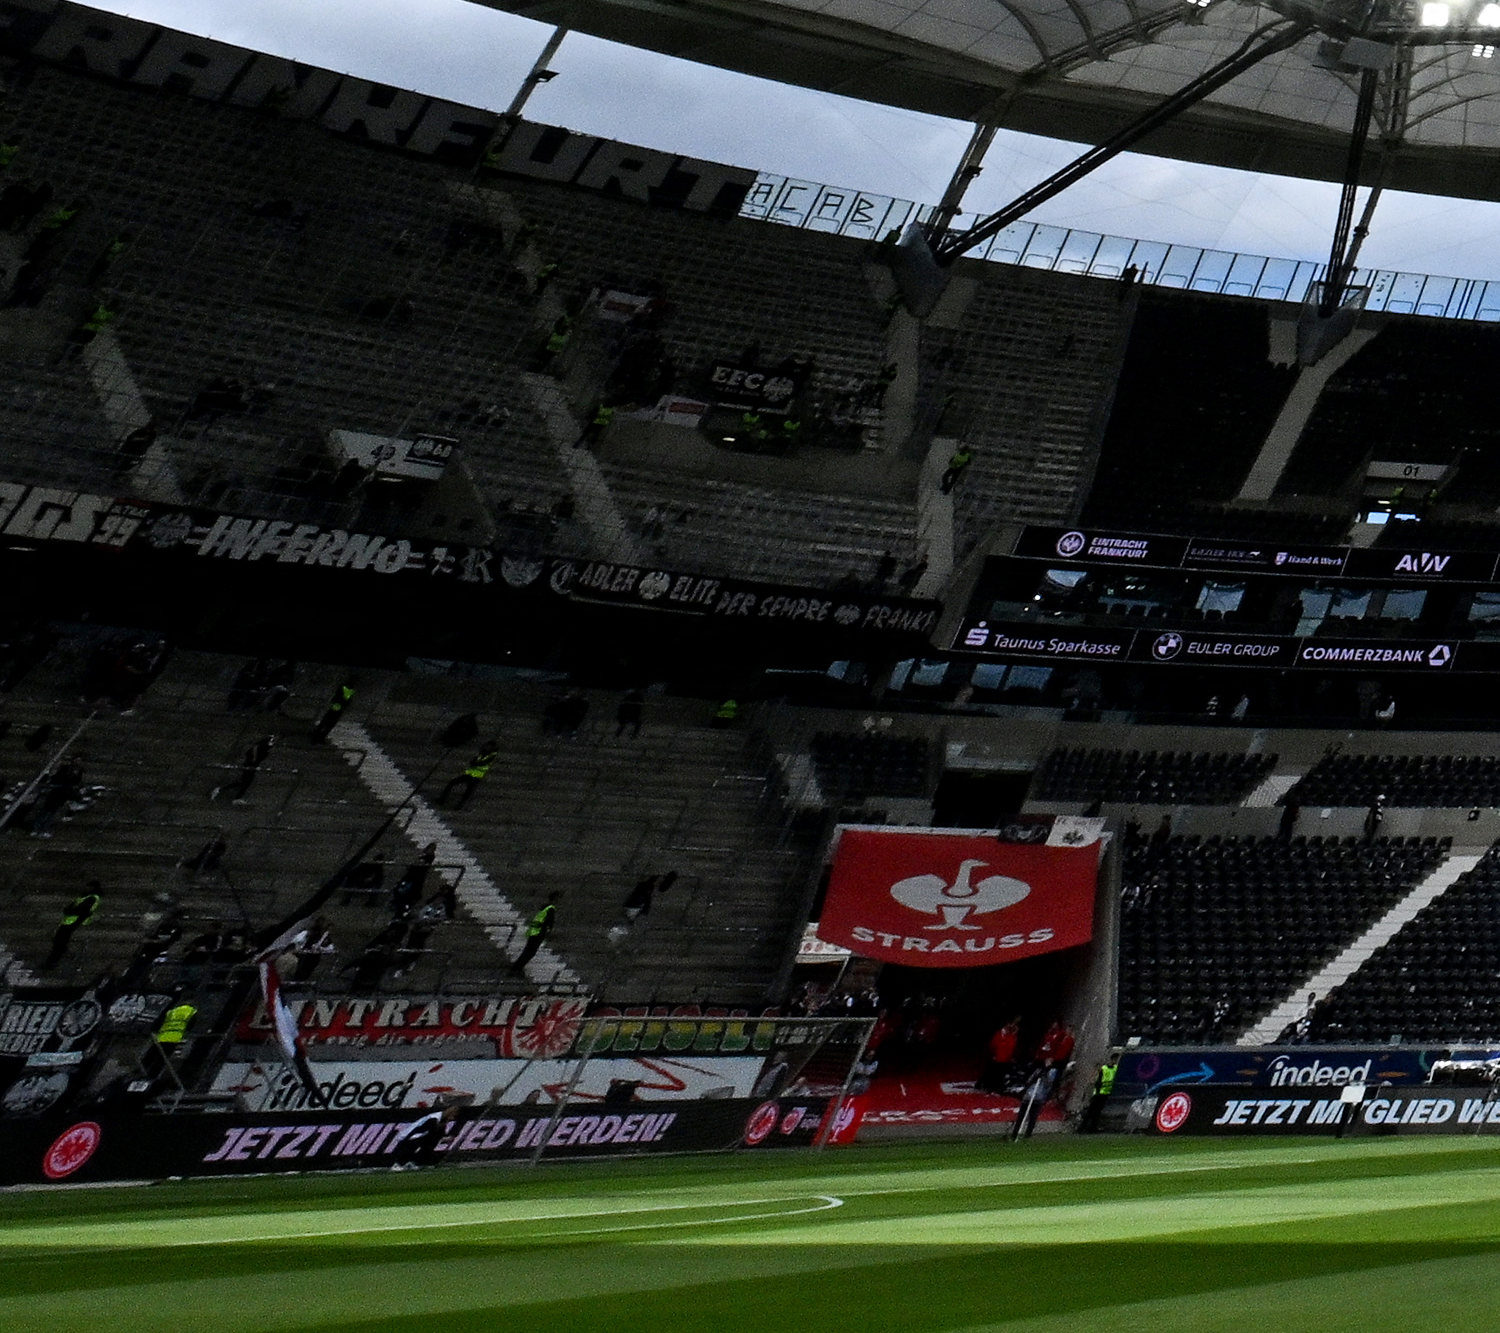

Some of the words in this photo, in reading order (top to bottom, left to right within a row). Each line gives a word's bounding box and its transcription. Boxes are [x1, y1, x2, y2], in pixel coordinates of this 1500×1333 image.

[1403, 465, 1420, 477] 01
[197, 515, 411, 574] INFERNO
[1087, 546, 1149, 560] FRANKFURT
[1091, 536, 1149, 550] EINTRACHT
[993, 632, 1044, 652] Taunus
[1047, 636, 1122, 656] Sparkasse
[1186, 641, 1232, 656] EULER
[1233, 643, 1281, 658] GROUP
[1302, 646, 1423, 663] COMMERZBANK
[851, 927, 1055, 954] STRAUSS
[249, 998, 547, 1030] ENTRACHT
[1267, 1055, 1372, 1087] indeed
[270, 1071, 418, 1111] indeed
[1213, 1100, 1311, 1124] JETZT
[1307, 1098, 1457, 1124] MGLIED
[201, 1123, 343, 1165] JETZT
[331, 1115, 517, 1158] MITLIED
[515, 1112, 678, 1150] WERDEN!
